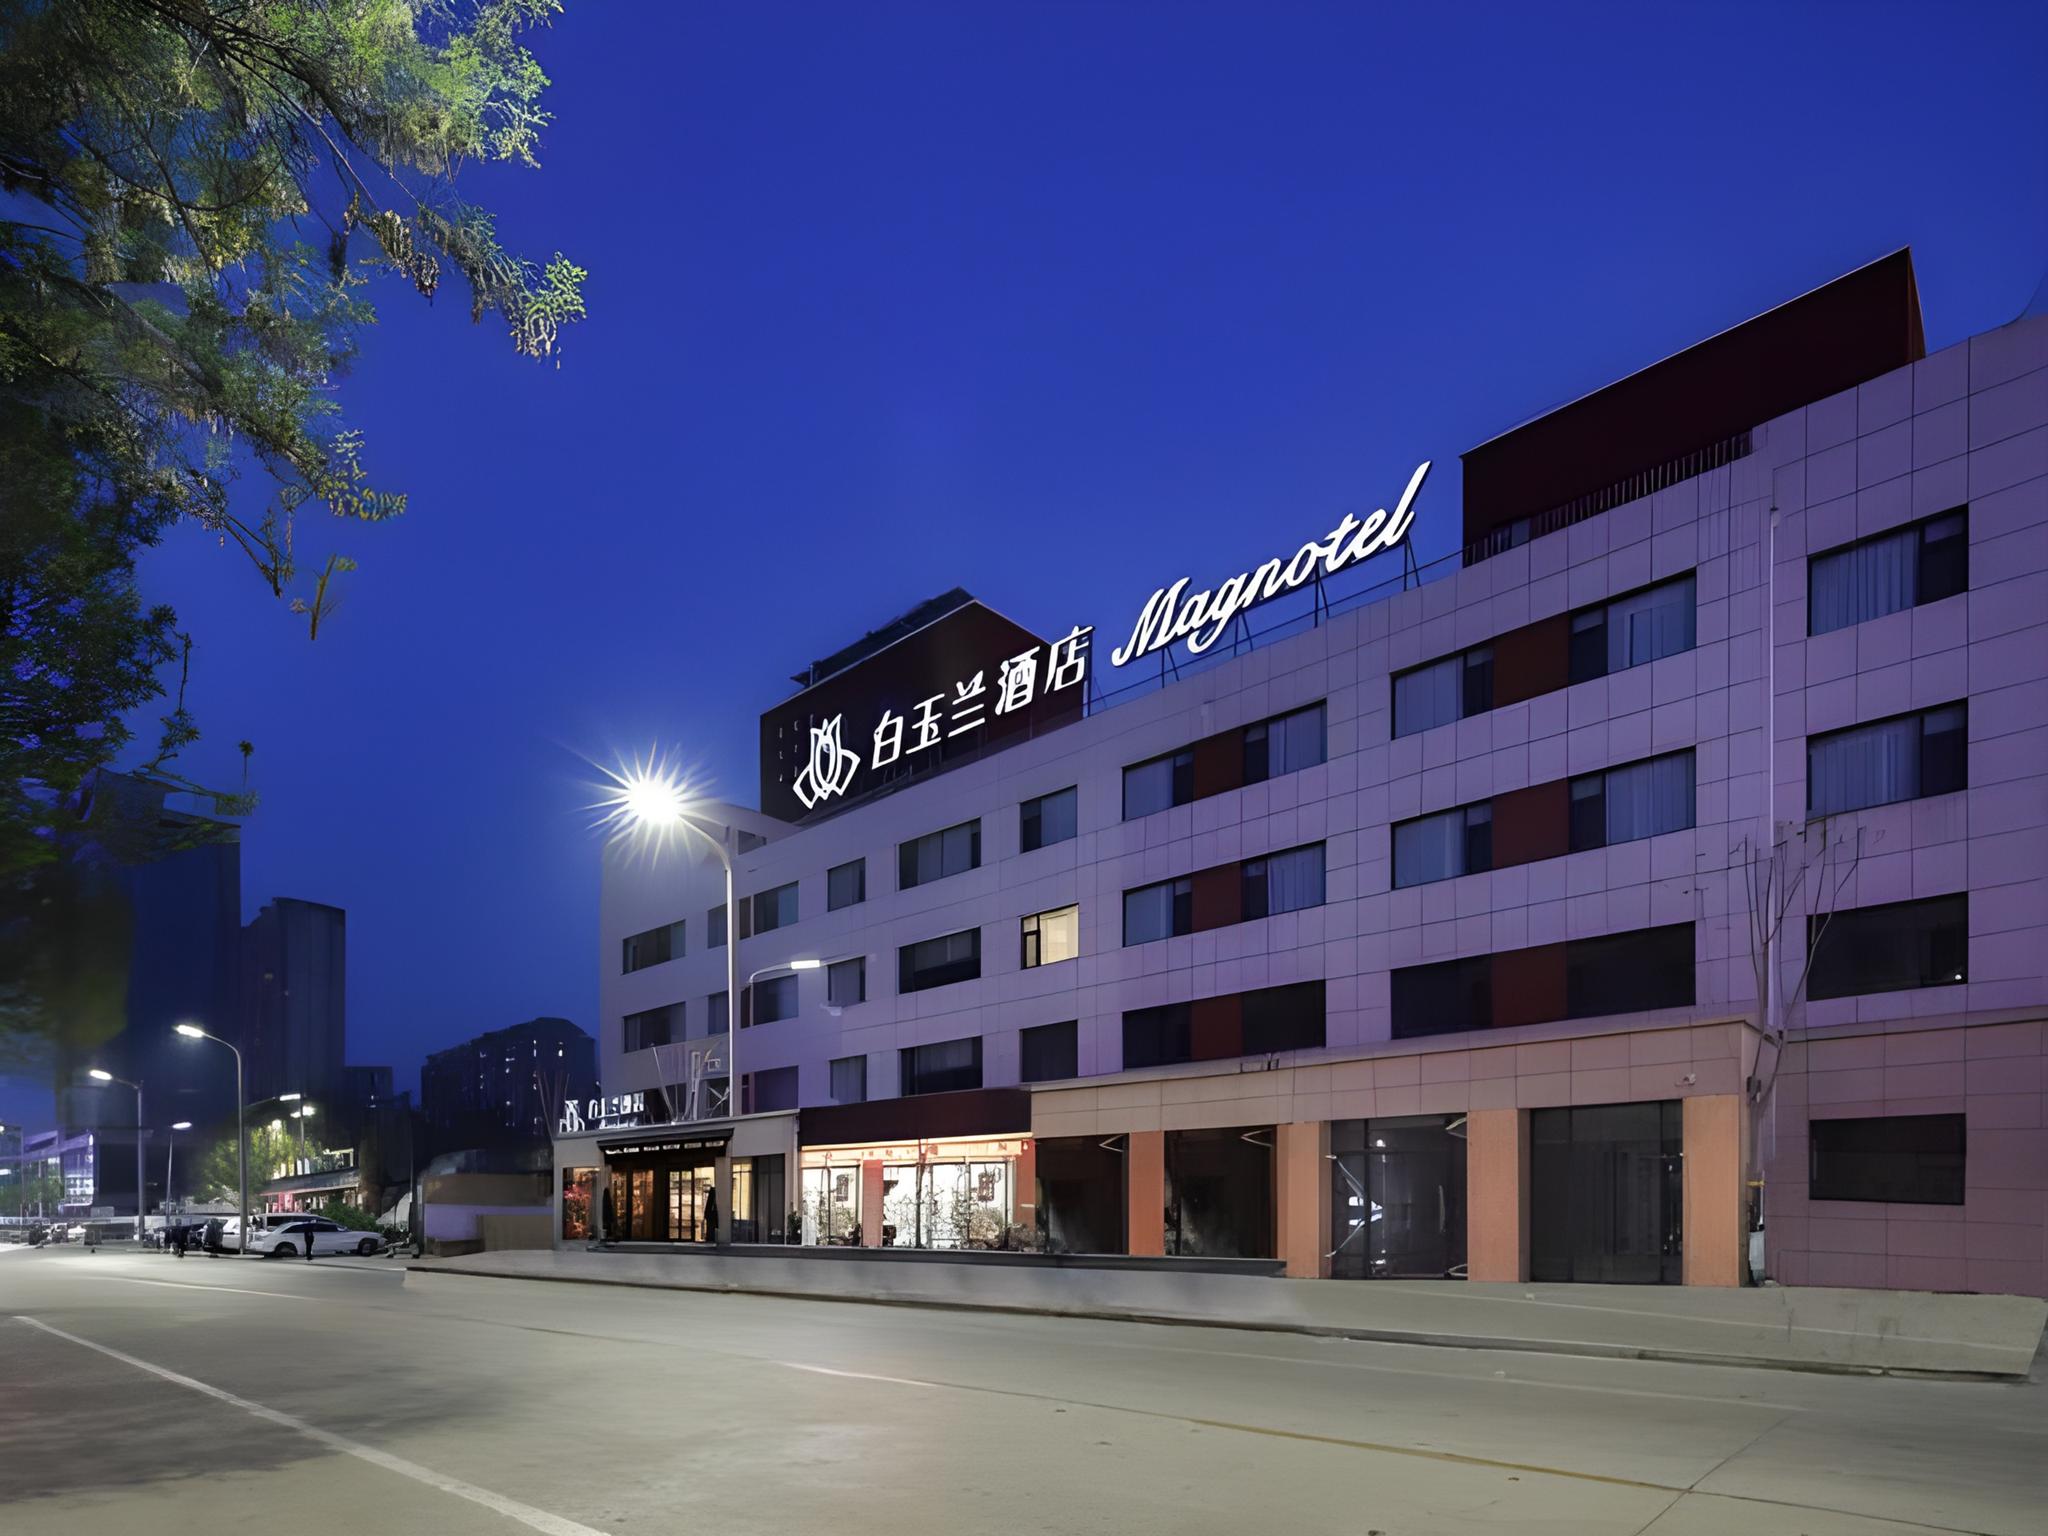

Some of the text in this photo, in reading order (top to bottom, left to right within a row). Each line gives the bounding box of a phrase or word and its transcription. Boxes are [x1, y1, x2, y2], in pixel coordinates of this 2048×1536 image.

[1111, 460, 1431, 667] Magnotel
[871, 625, 1094, 770] 白玉兰酒店
